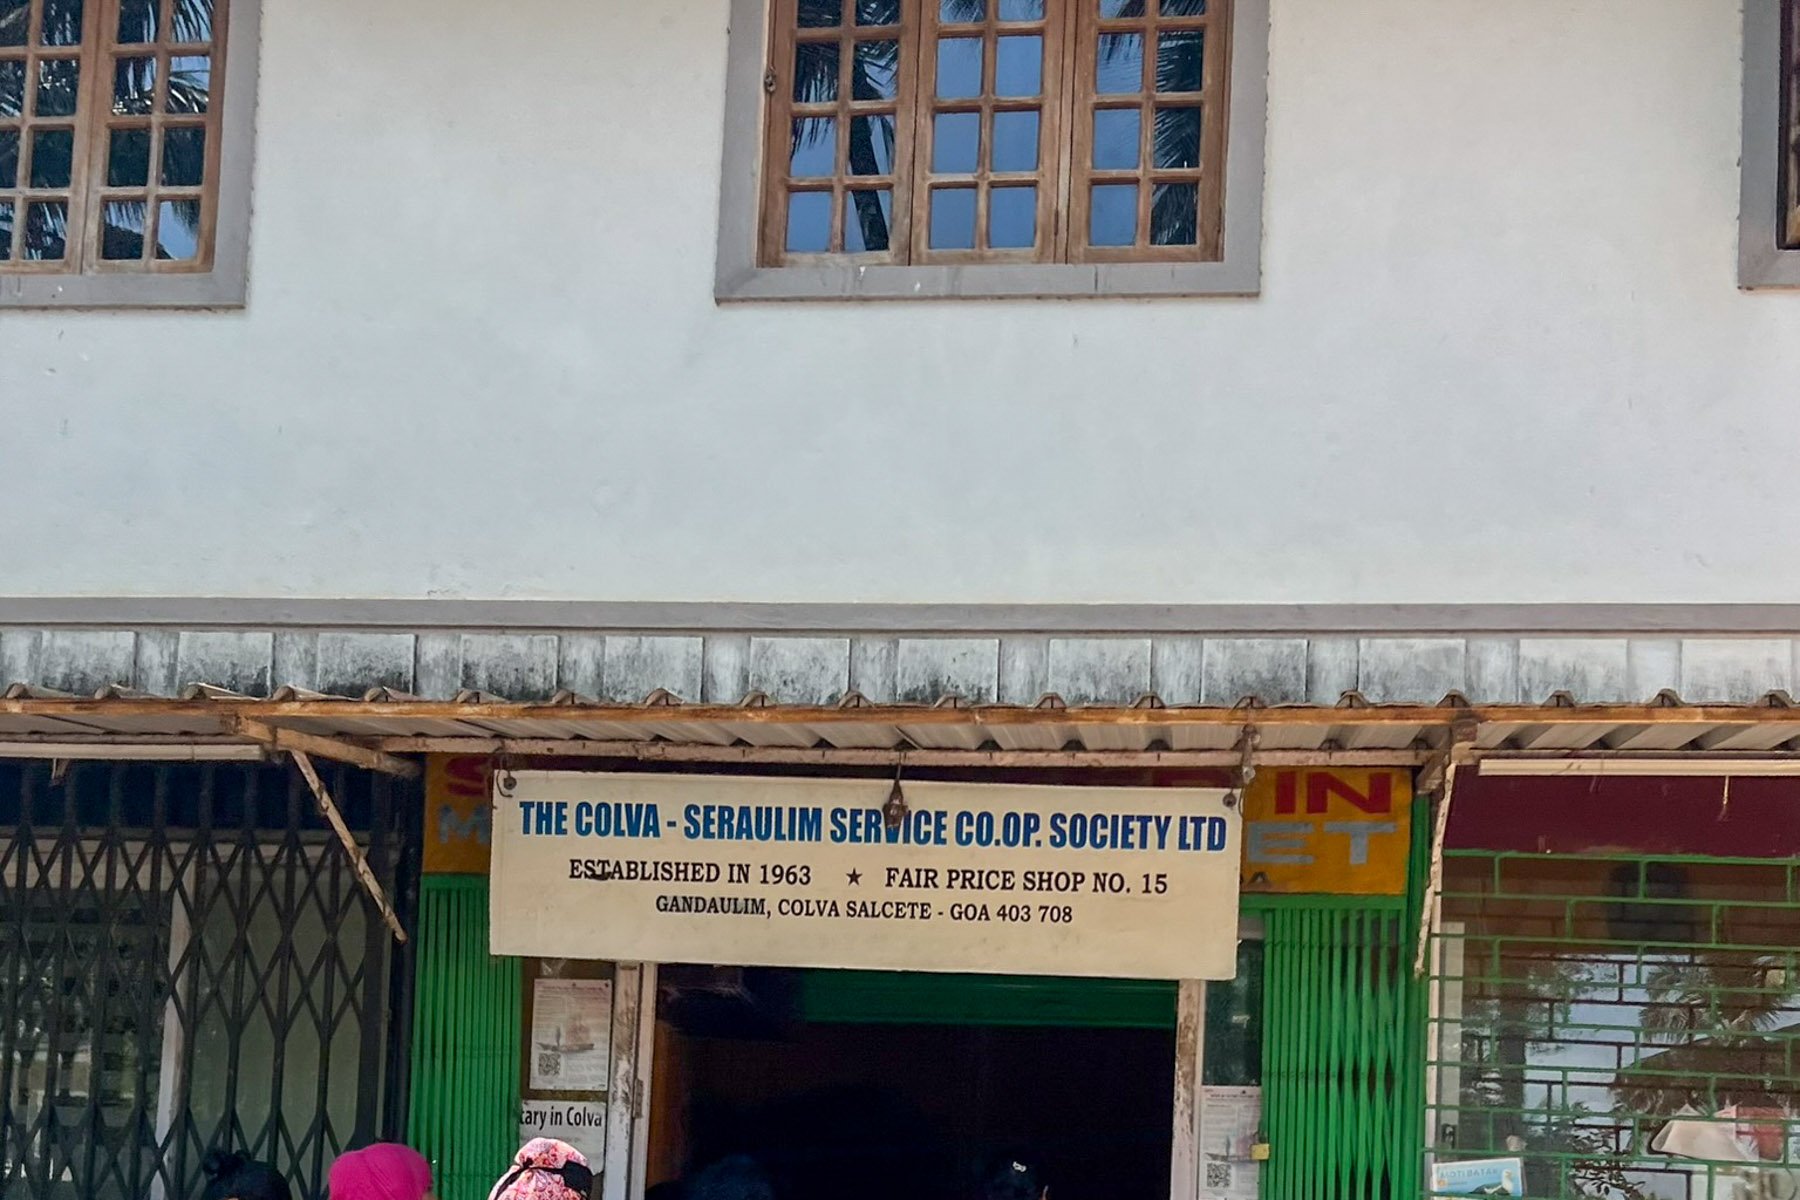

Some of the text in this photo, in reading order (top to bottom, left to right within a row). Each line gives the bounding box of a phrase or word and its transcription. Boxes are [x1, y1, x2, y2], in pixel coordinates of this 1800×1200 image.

[519, 801, 567, 835] THE
[575, 802, 661, 838] COLVA
[684, 804, 822, 842] SERAULIM
[830, 808, 947, 845] SERVICE
[955, 811, 1041, 848] CO.OP.
[1050, 813, 1172, 850] SOCIETY
[1178, 816, 1227, 852] LTD
[569, 859, 1168, 894] ESTABLISHED IN 1963 FAIR PRICE SHOP NO. 15
[656, 895, 772, 919] GANDAULIM,
[778, 899, 840, 917] COLVA
[846, 900, 931, 919] SALCETE
[950, 904, 990, 921] GOA
[996, 905, 1031, 922] 403
[1038, 906, 1073, 923] 708
[550, 1105, 563, 1127] in
[566, 1106, 603, 1128] Colva
